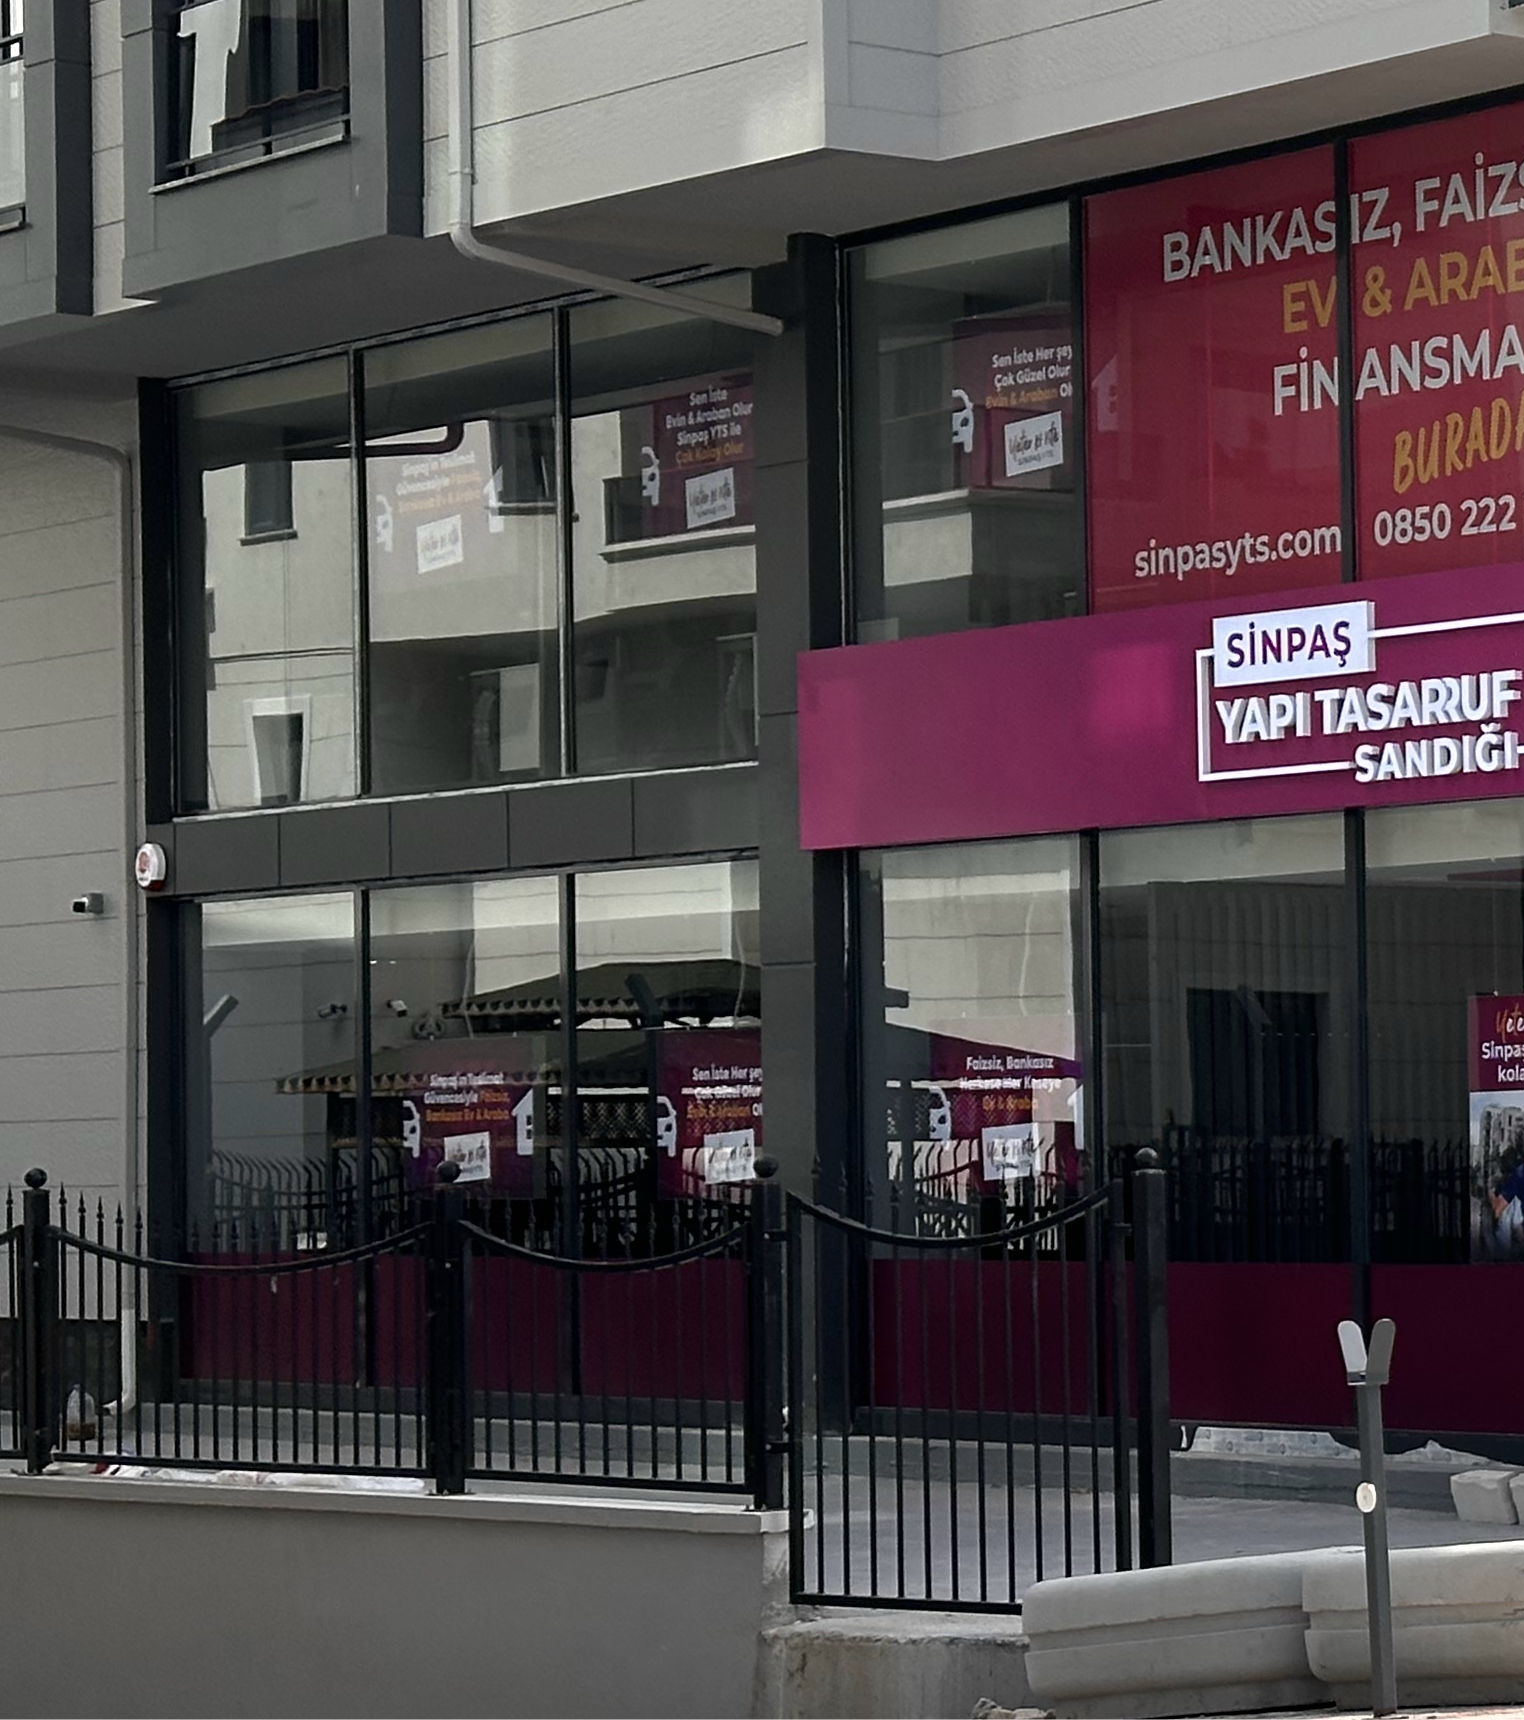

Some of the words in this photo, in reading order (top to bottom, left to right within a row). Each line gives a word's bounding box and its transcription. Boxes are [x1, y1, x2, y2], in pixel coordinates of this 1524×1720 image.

[1283, 275, 1337, 333] EV
[1362, 266, 1392, 317] &
[1016, 367, 1046, 386] Güzel
[1048, 365, 1071, 378] Olur
[1374, 504, 1451, 546] 0850
[1461, 495, 1516, 535] 222
[1134, 523, 1342, 580] sinpasyts.com
[1226, 618, 1352, 670] SİNPAŞ
[1216, 687, 1311, 743] YAPI
[1315, 669, 1522, 734] TASARRUF
[1354, 724, 1521, 783] SANDIĞI
